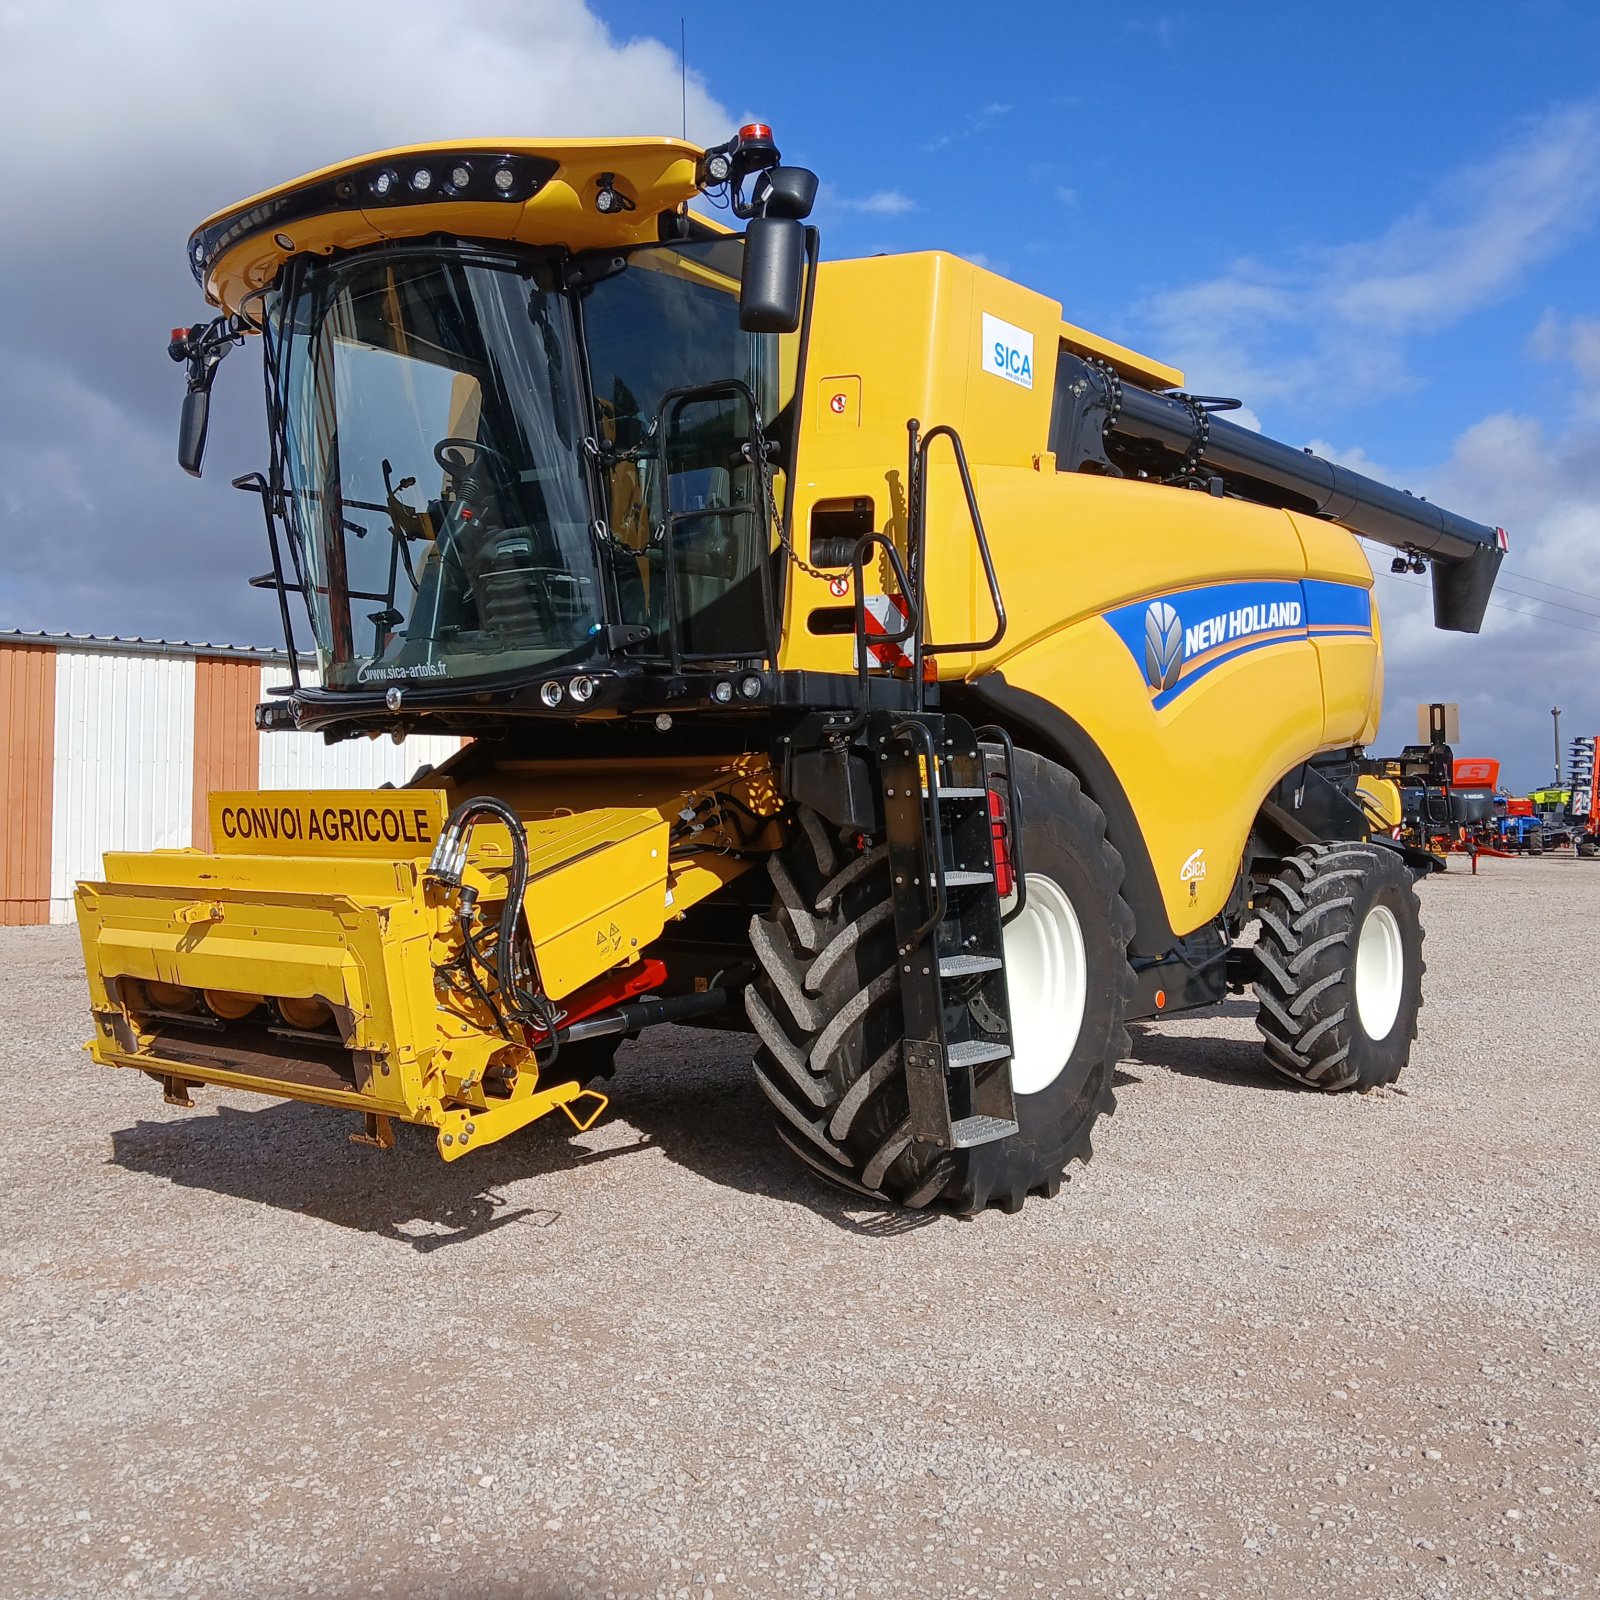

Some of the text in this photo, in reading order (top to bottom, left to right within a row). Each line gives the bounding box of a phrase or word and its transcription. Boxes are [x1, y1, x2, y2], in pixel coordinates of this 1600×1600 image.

[994, 342, 1032, 380] SICA
[1185, 602, 1301, 657] NEW HOLLAND
[364, 660, 447, 680] www.sica-artois.fr
[221, 807, 432, 843] CONVOI AGRICOLE
